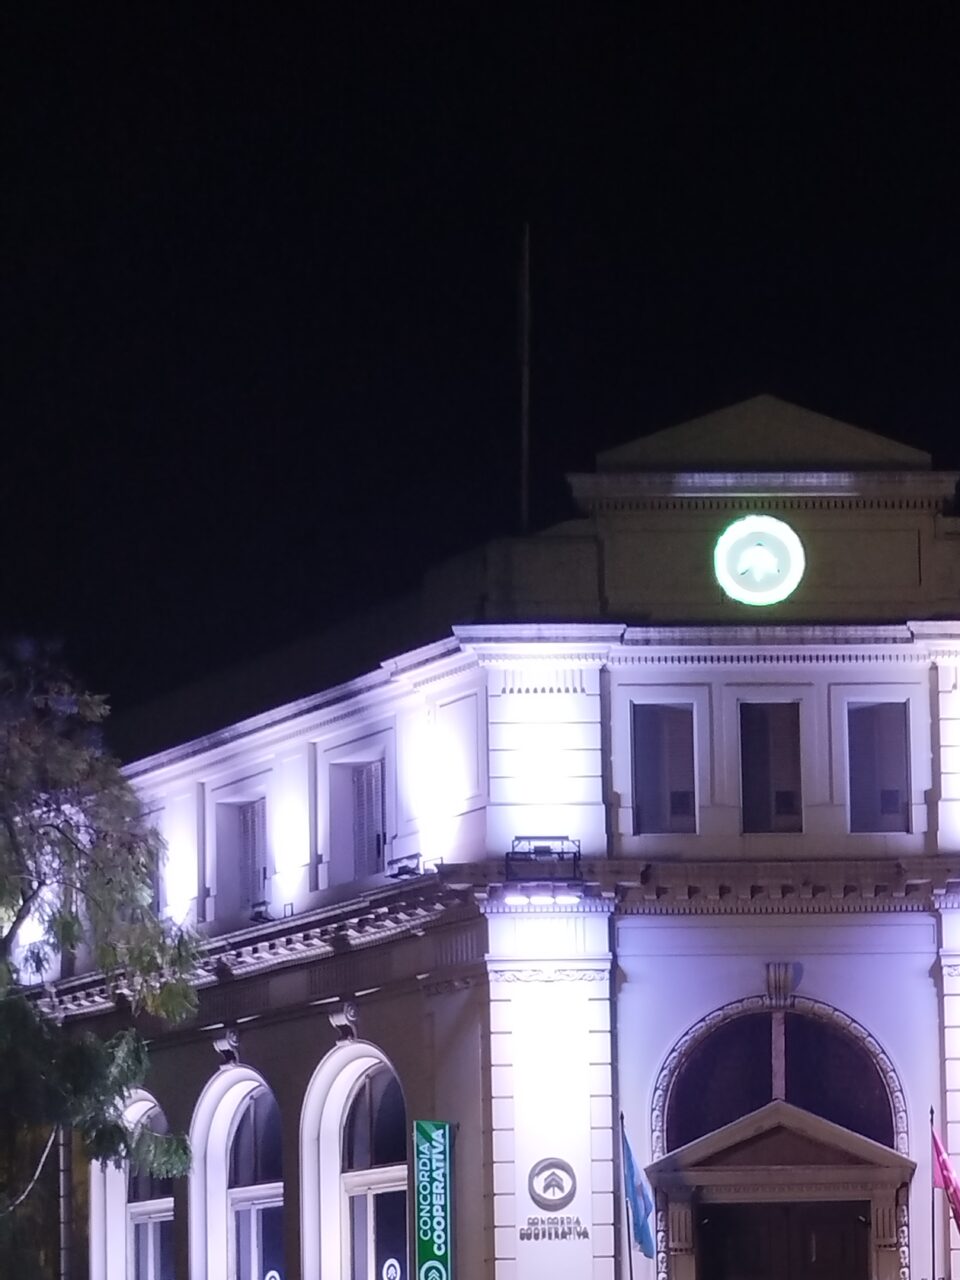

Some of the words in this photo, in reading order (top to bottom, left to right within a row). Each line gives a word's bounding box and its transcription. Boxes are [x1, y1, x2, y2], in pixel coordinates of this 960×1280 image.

[420, 1142, 431, 1241] CONCORDIA
[432, 1129, 446, 1256] COOPERATIVA
[519, 1227, 590, 1241] COOPERATIVA
